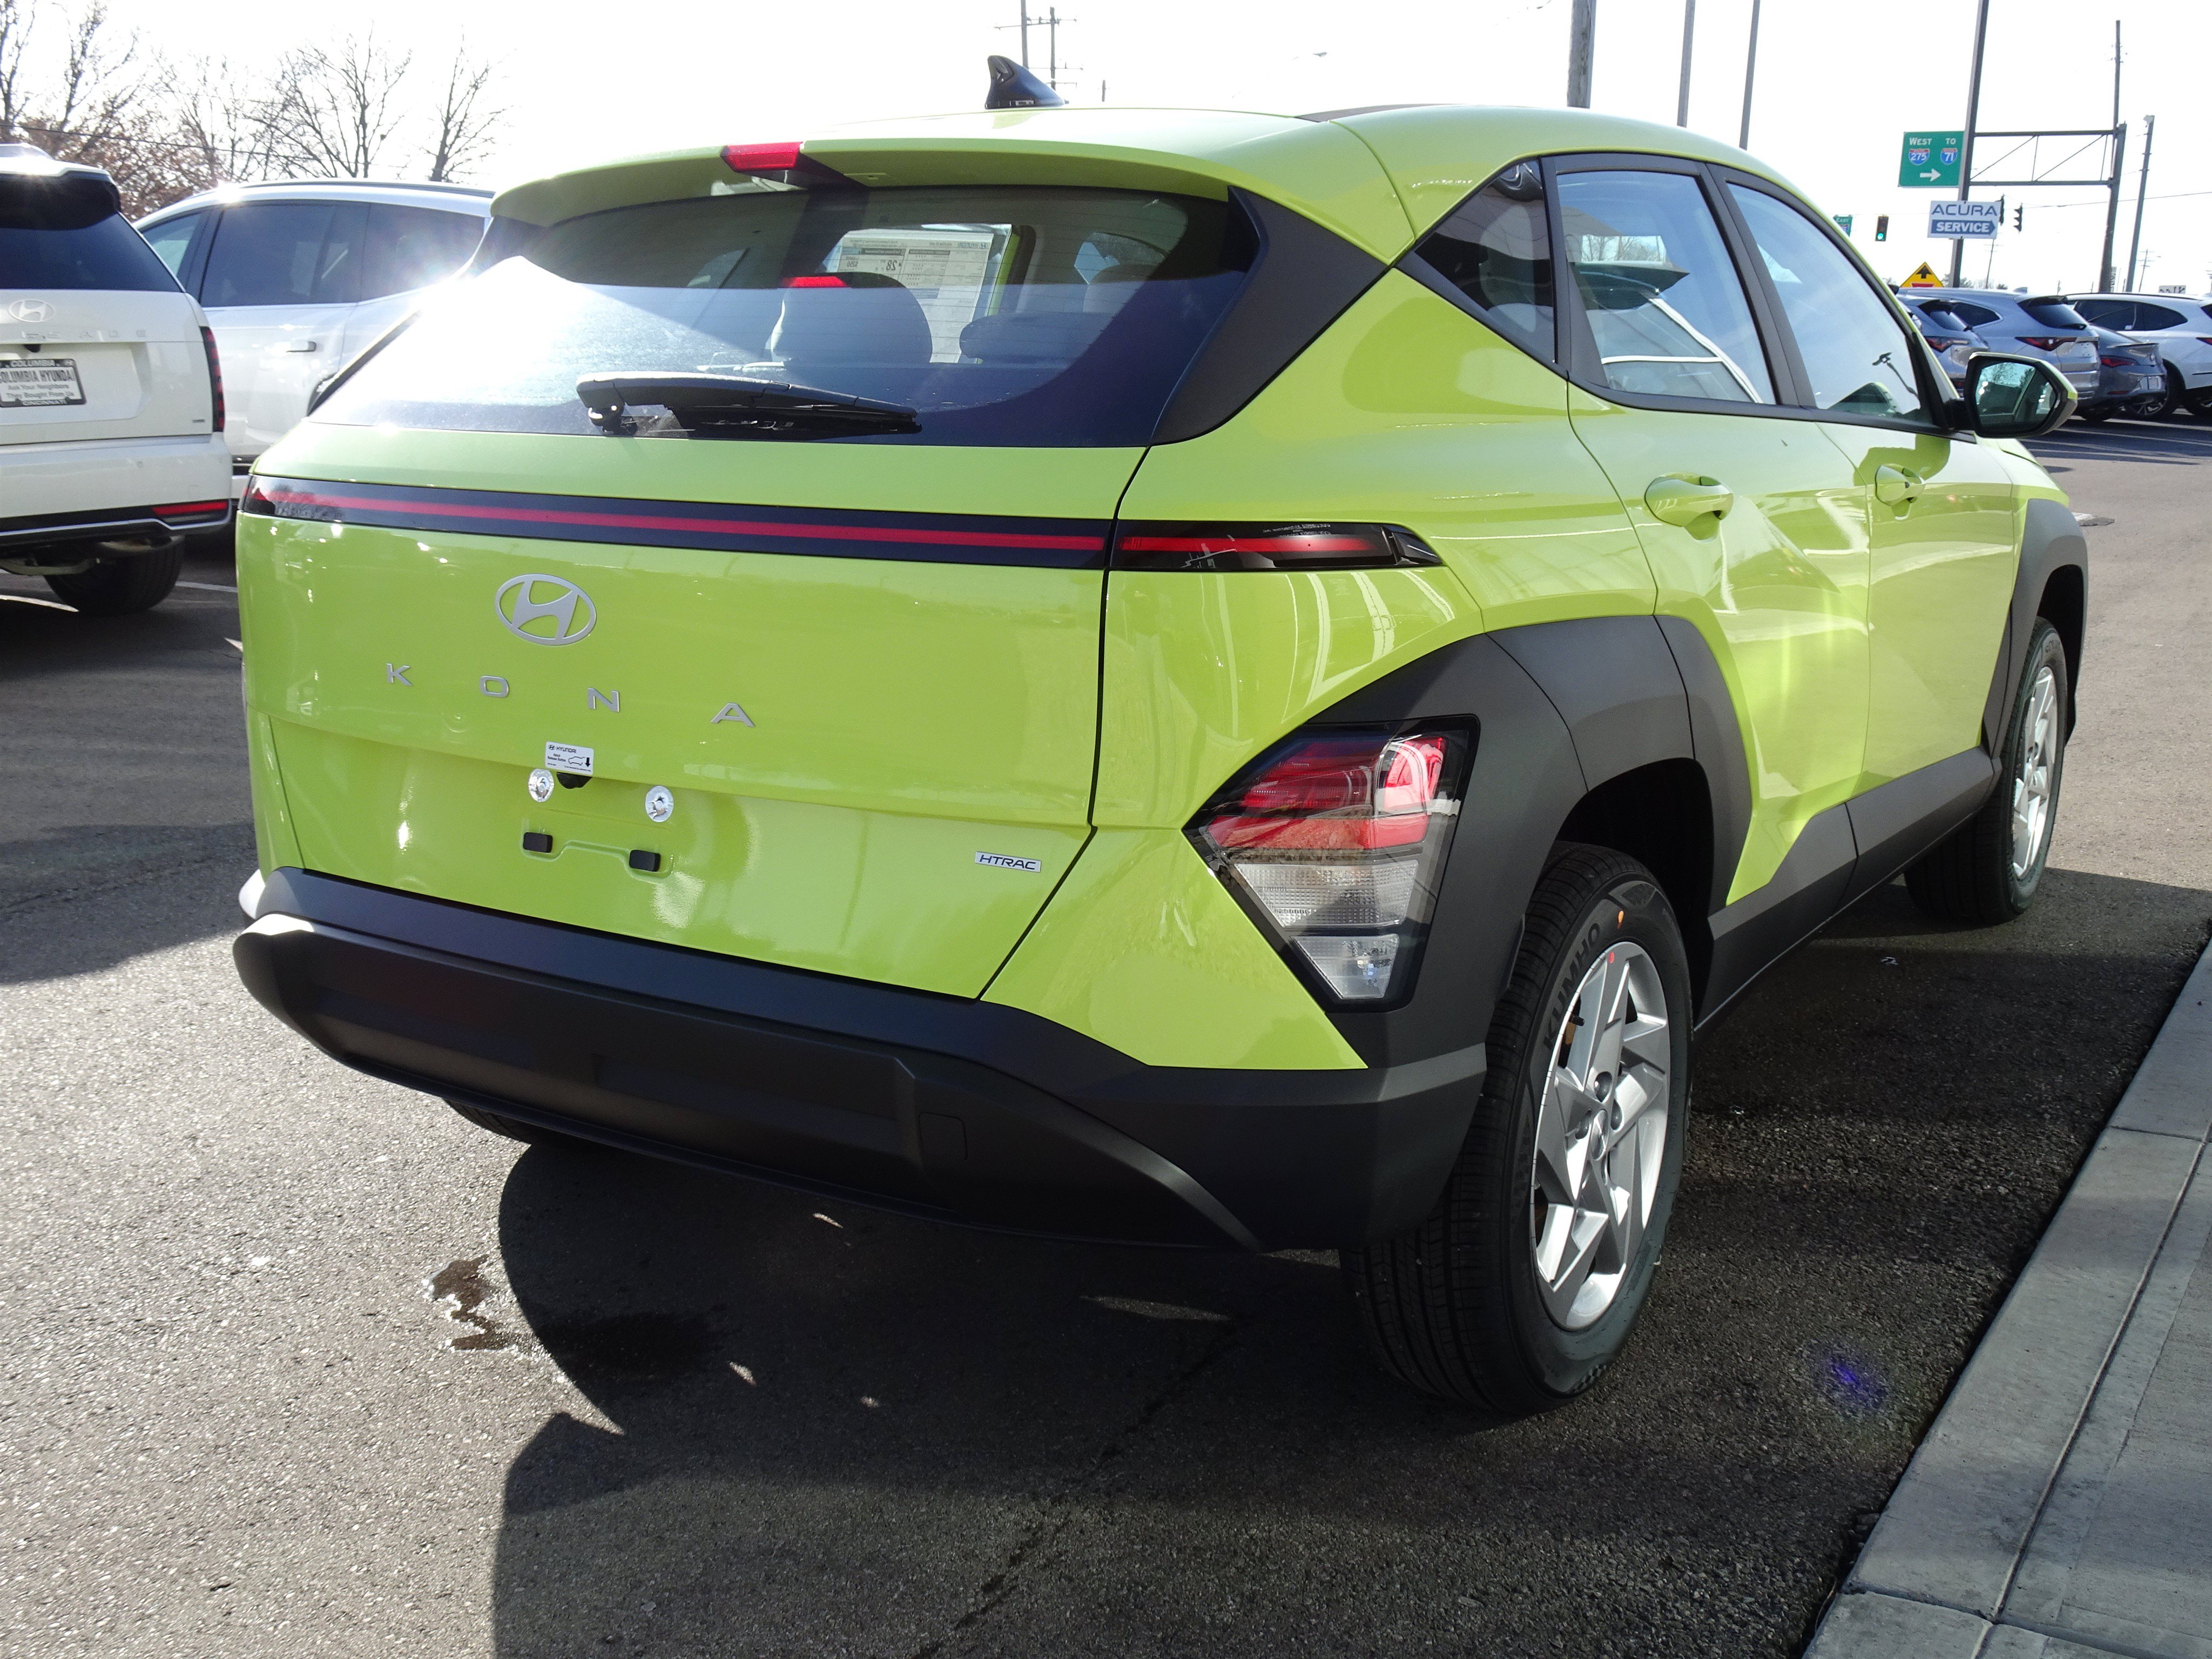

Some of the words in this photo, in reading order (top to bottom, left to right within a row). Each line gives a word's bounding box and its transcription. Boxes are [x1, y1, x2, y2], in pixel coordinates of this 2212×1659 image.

[1908, 137, 1932, 145] WEST
[1910, 152, 1927, 161] 275
[1944, 152, 1954, 161] 71
[1931, 204, 1998, 216] ACURA
[1936, 221, 1990, 233] SERVICE
[0, 370, 39, 383] OLUMBIA
[386, 663, 756, 727] KONA
[980, 854, 1036, 870] HTRAC
[1542, 922, 1600, 1051] KUMHO
